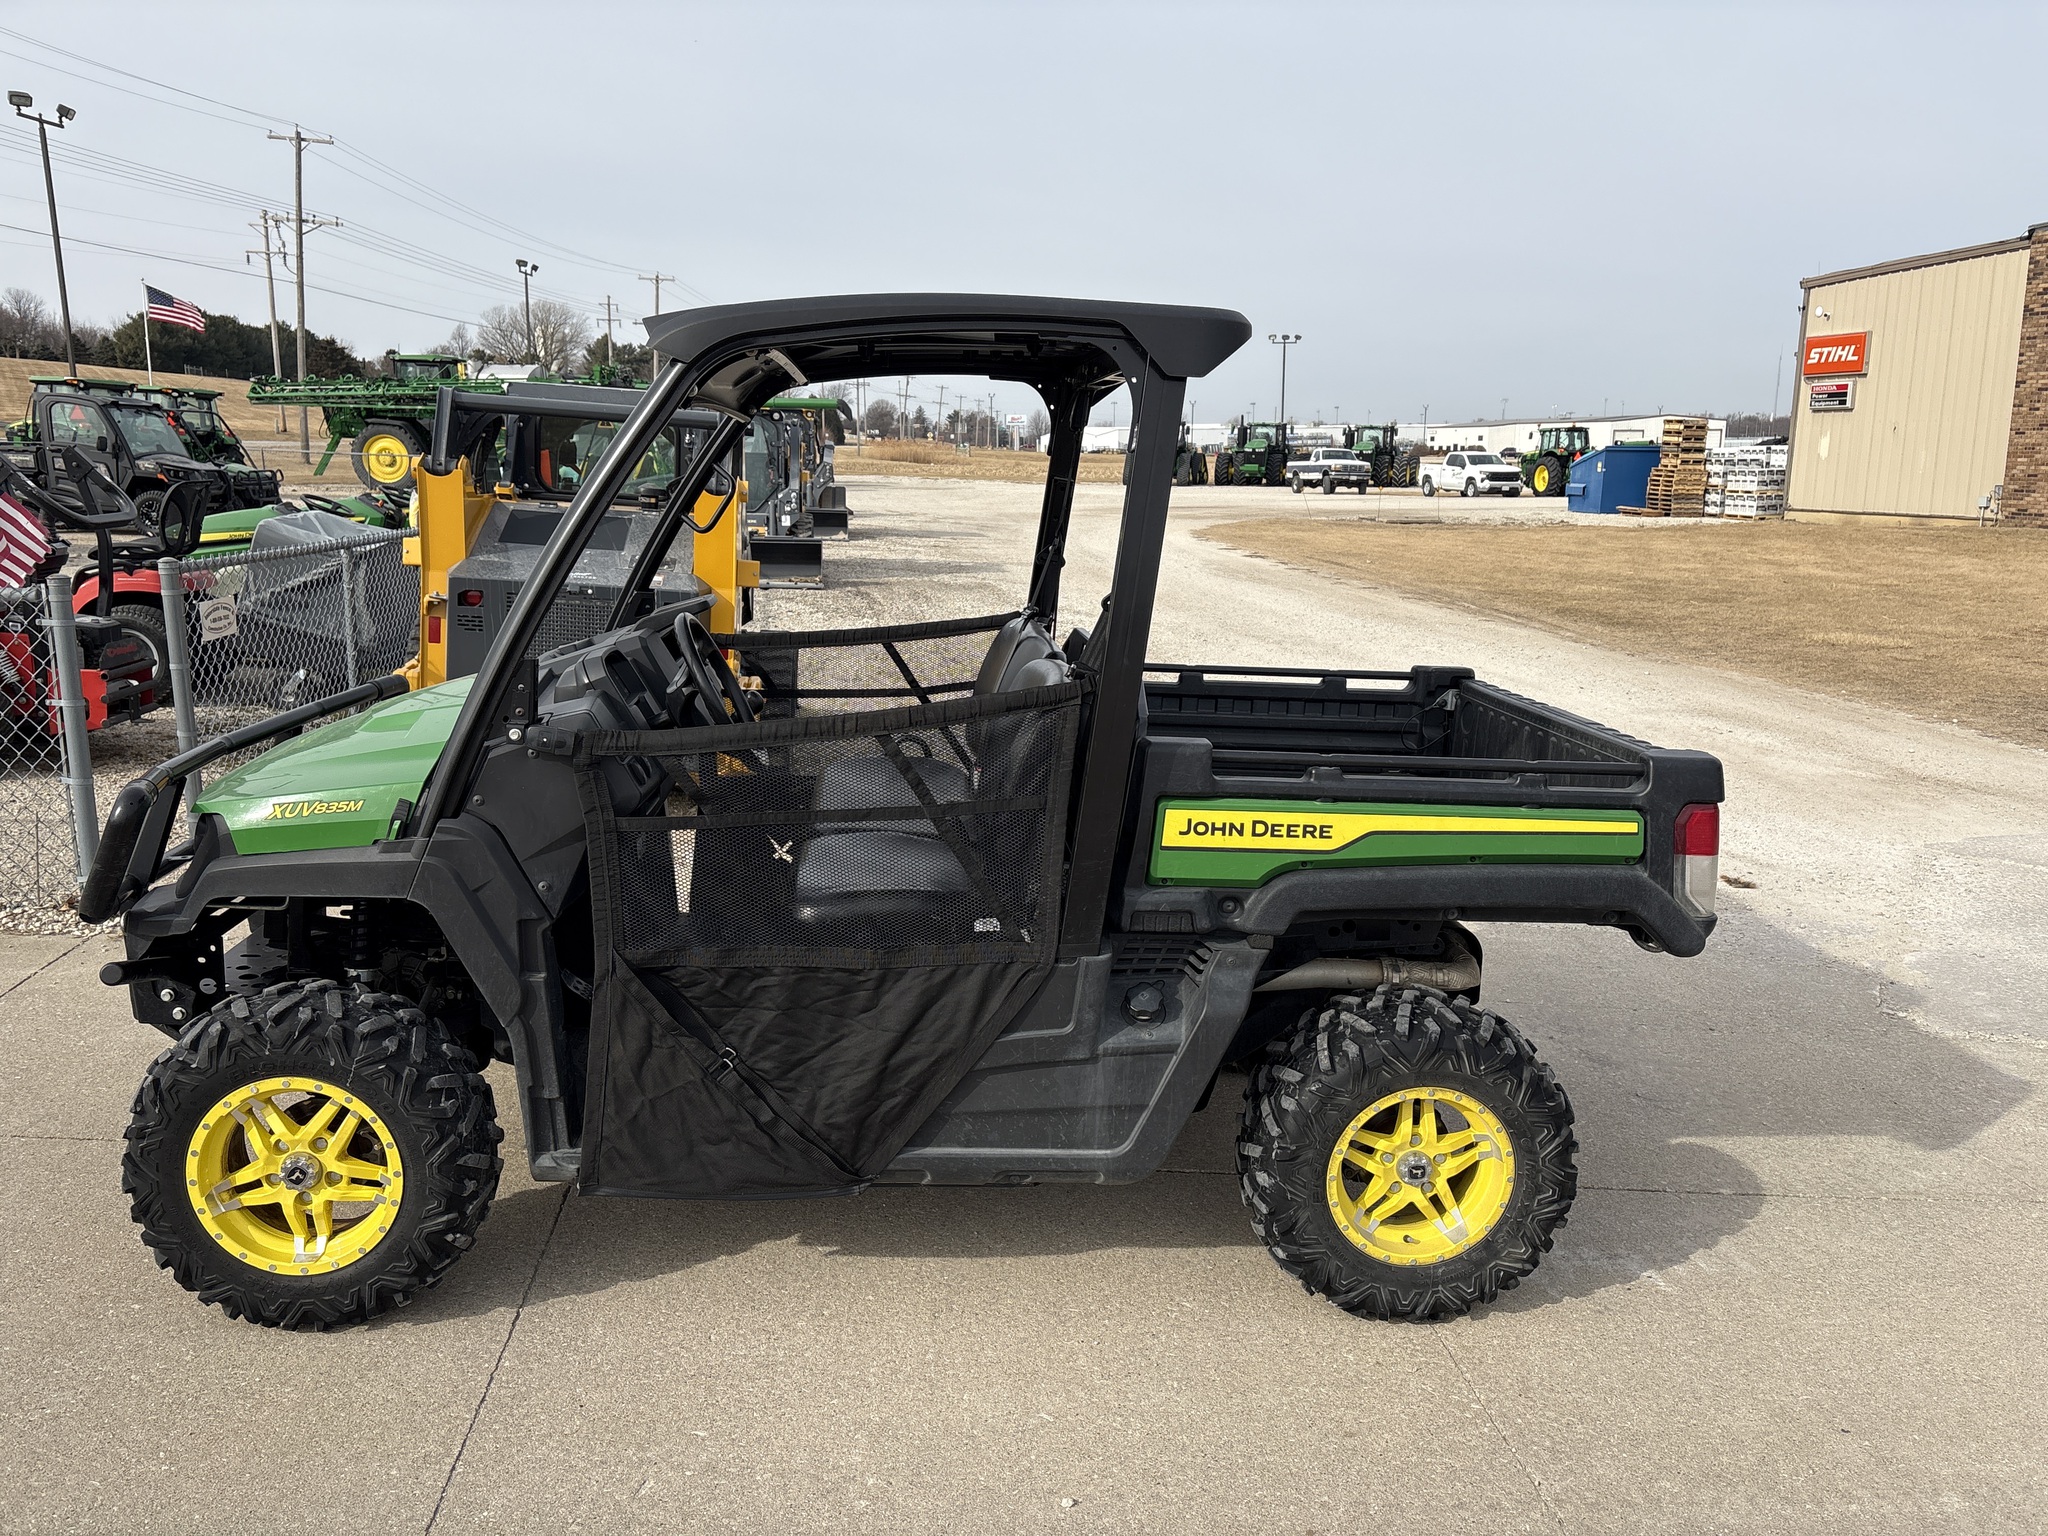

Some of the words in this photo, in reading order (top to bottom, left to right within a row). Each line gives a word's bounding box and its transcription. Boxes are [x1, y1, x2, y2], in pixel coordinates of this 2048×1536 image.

[1806, 345, 1860, 364] STIHL
[265, 799, 365, 820] XUV835M
[1178, 818, 1245, 837] JOHN
[1251, 819, 1334, 840] DEERE
